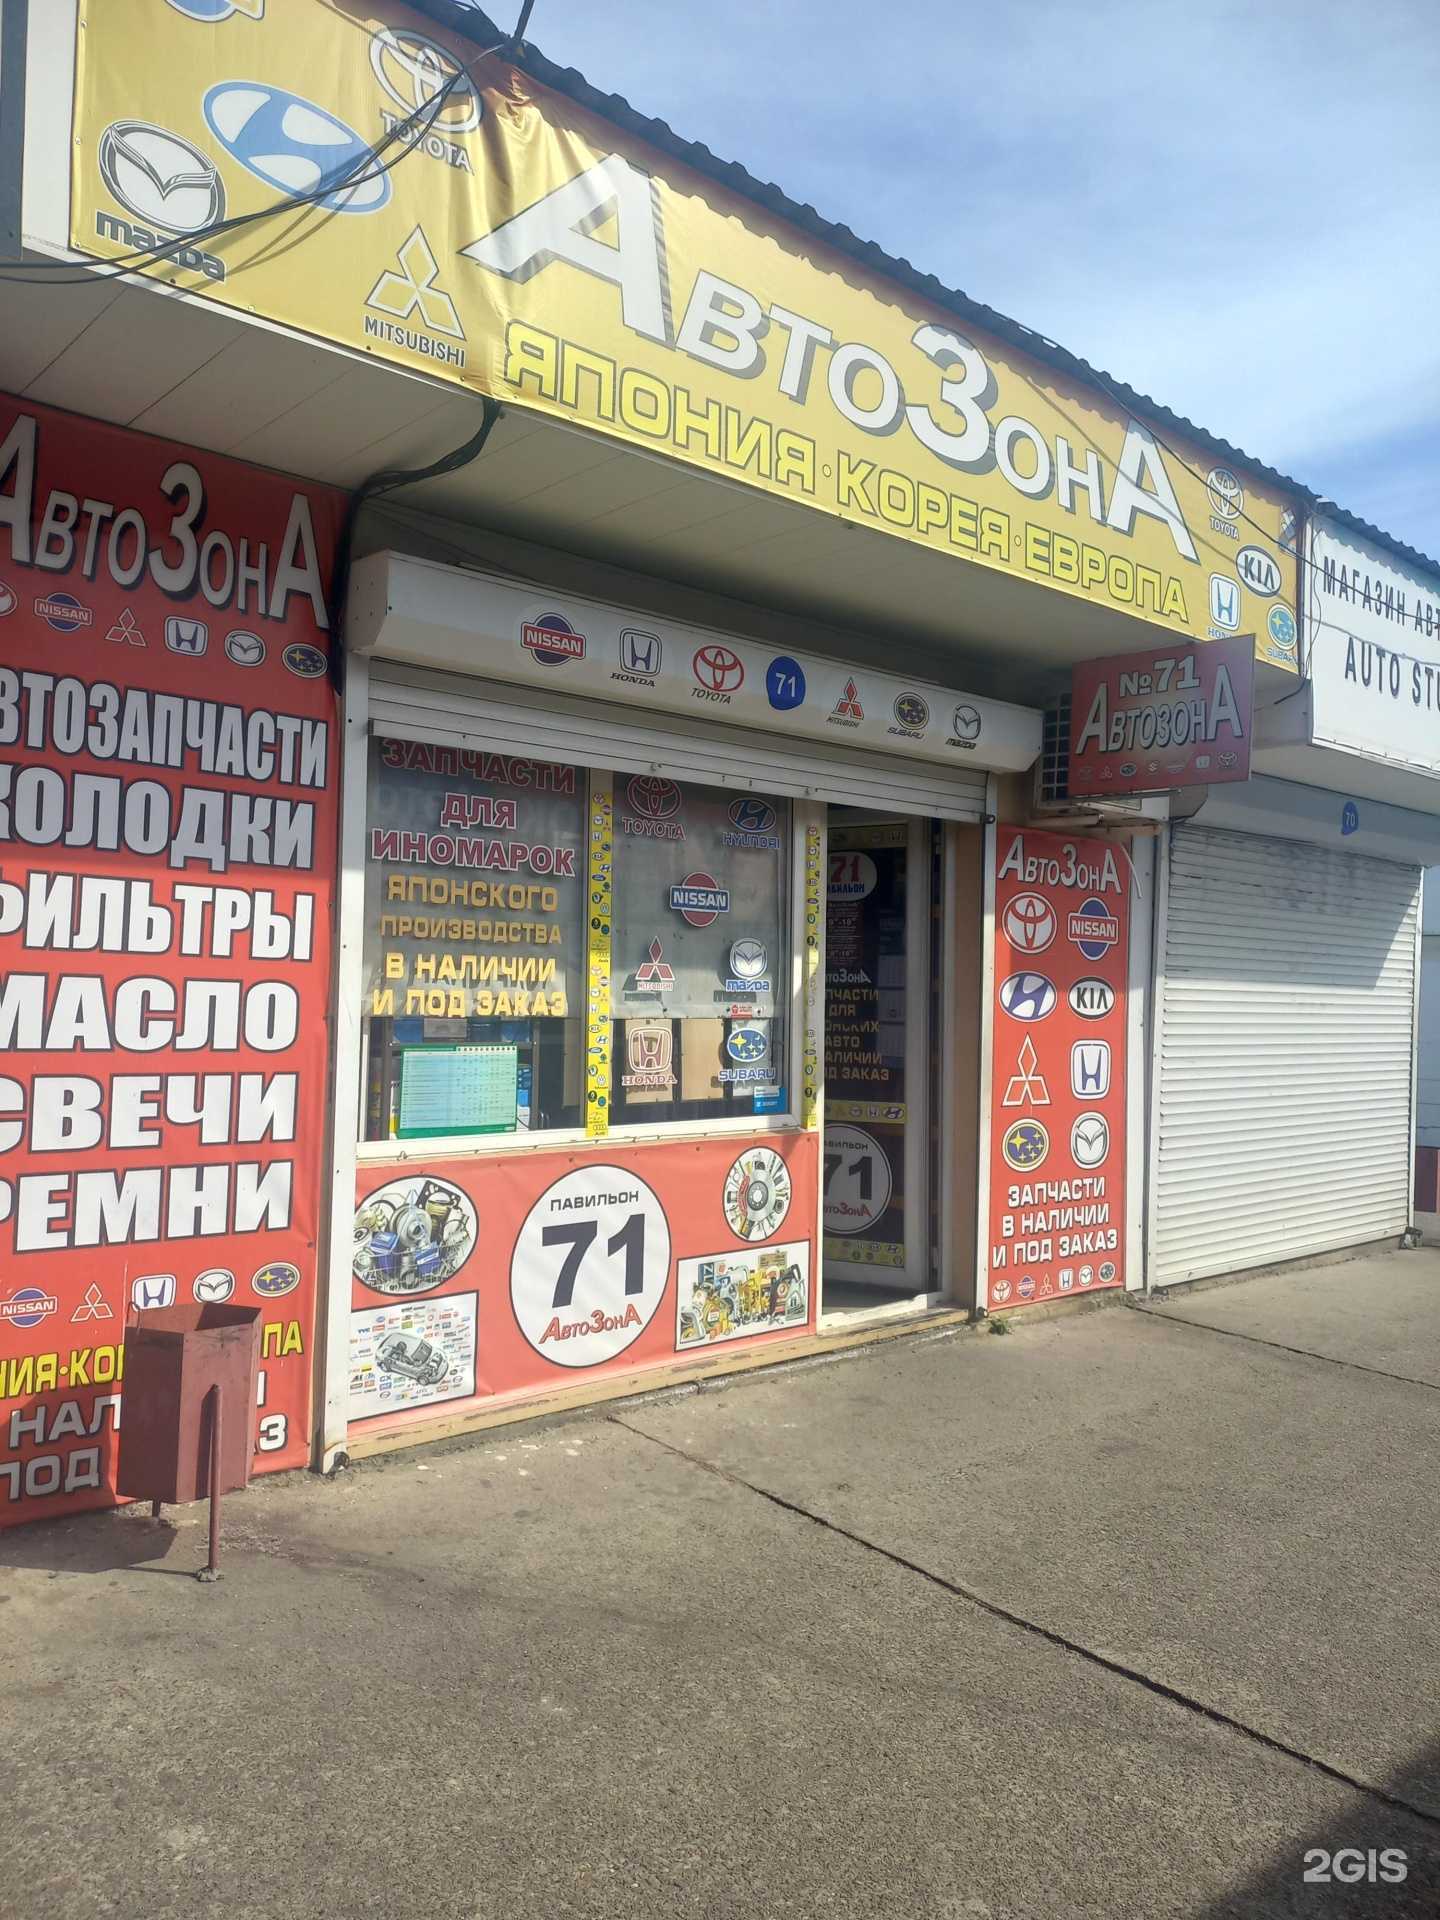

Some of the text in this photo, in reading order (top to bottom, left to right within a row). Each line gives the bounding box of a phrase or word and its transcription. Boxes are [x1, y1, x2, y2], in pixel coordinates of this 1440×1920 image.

[380, 110, 477, 176] TOYOTA
[364, 314, 466, 369] MITSUBISHI
[1209, 515, 1240, 542] TOYOTA
[1244, 553, 1275, 591] KIA
[1323, 555, 1406, 626] МАГАЗИН
[38, 602, 89, 621] NISSAN
[525, 630, 583, 654] NISSAN
[609, 672, 656, 688] HONDA
[775, 672, 797, 698] 71
[1344, 636, 1440, 713] AUTO ST
[690, 687, 732, 705] TOYOTA
[887, 727, 925, 740] SUBARU
[382, 738, 576, 794] ЗАПЧАСТИ
[0, 764, 315, 872] ОЛОДКИ
[440, 792, 517, 830] ДЛЯ
[622, 816, 687, 841] TOYOTA
[371, 828, 576, 877] ИНОМАРОК
[387, 874, 558, 913] ЯПОНСКОГО
[673, 891, 727, 908] NISSAN
[380, 915, 562, 946] ПРОИЗВОДСТВА
[1071, 920, 1116, 938] NISSAN
[386, 952, 556, 983] В НАЛИЧИИ
[373, 990, 568, 1017] И ПОД ЗАКАЗ
[829, 1004, 856, 1017] ДЛЯ
[1075, 986, 1109, 1010] KIA
[621, 1074, 678, 1087] HONDA
[719, 1067, 776, 1082] SUBARU
[841, 1067, 891, 1082] ЗАКАЗ
[550, 1190, 639, 1212] ПАВИЛЬОН
[1008, 1175, 1106, 1208] ЗАПЧАСТИ
[0, 1160, 294, 1254] ЕМНИ
[1002, 1202, 1110, 1238] В НАЛИЧИИ
[541, 1213, 646, 1309] 71
[993, 1227, 1118, 1269] И ПОД ЗАКАЗ
[1, 1300, 54, 1316] NISSAN
